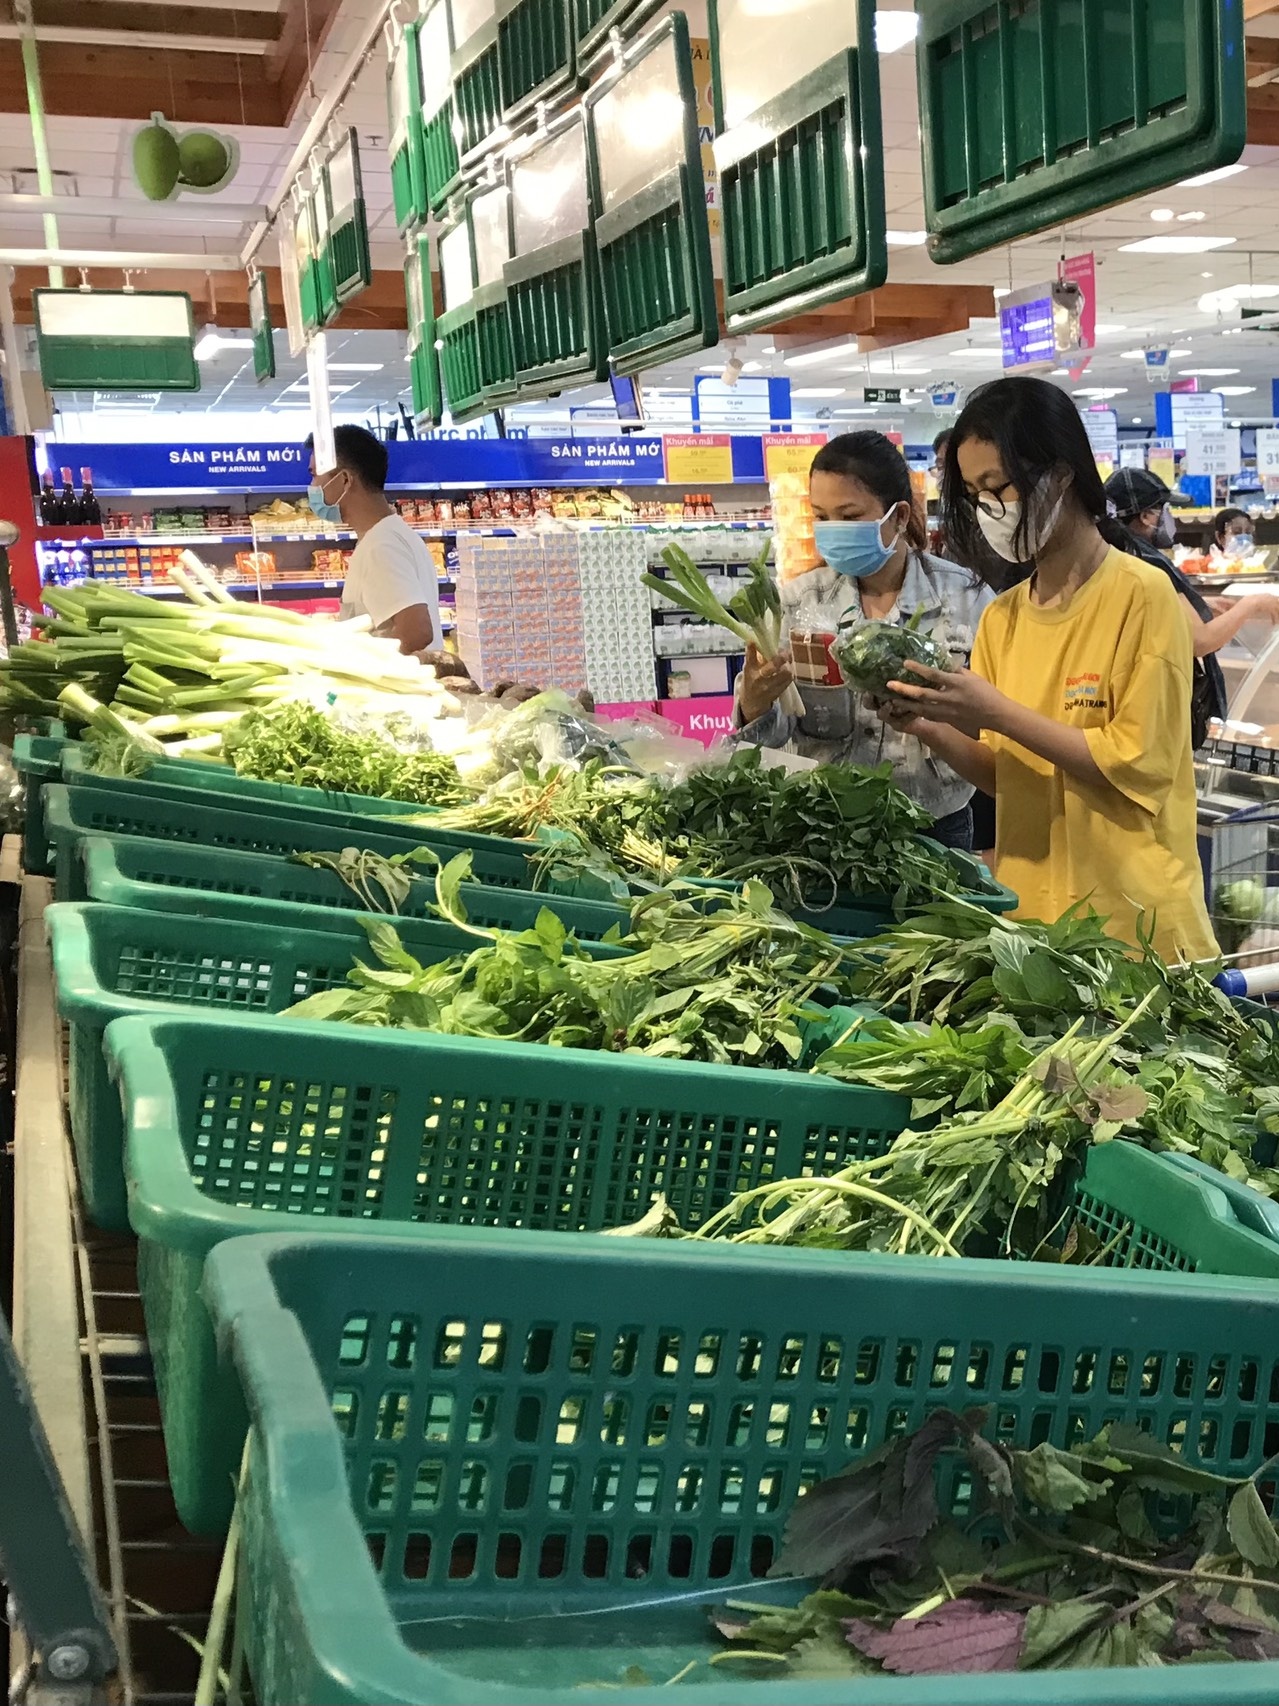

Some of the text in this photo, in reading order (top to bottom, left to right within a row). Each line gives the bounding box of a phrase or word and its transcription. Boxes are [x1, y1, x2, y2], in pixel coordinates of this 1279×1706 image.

[169, 446, 301, 463] SẢN PHẨM MỚI
[551, 442, 661, 458] SẢN PHẨM MỚ
[228, 465, 267, 473] ARRIVALS
[584, 459, 635, 467] NEW ARRIVALS
[689, 714, 735, 731] Khuy
